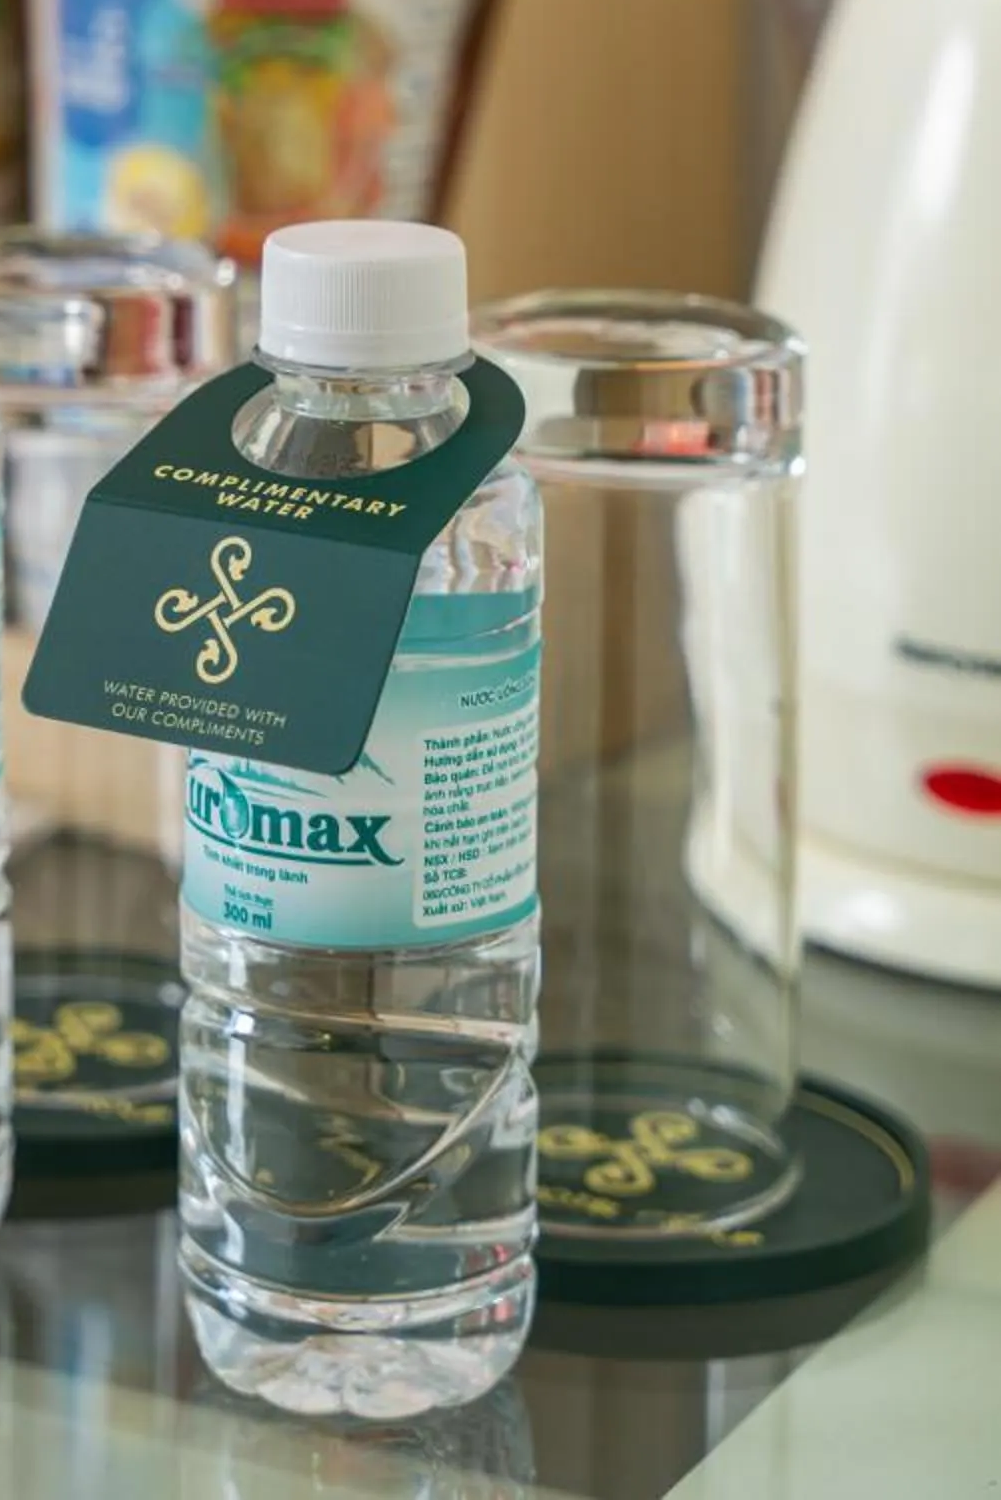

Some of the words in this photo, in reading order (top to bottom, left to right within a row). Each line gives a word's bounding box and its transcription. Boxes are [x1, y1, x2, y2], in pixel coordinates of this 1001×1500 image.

[153, 464, 407, 519] COMPLIMENTARY
[216, 491, 314, 521] WATER
[103, 680, 156, 703] WATER
[160, 691, 240, 719] PROVIDED
[245, 707, 286, 729] WITH
[111, 702, 148, 721] OUR
[151, 708, 265, 745] COMPLIMENTS
[223, 901, 248, 923] 300
[252, 911, 273, 930] ml
